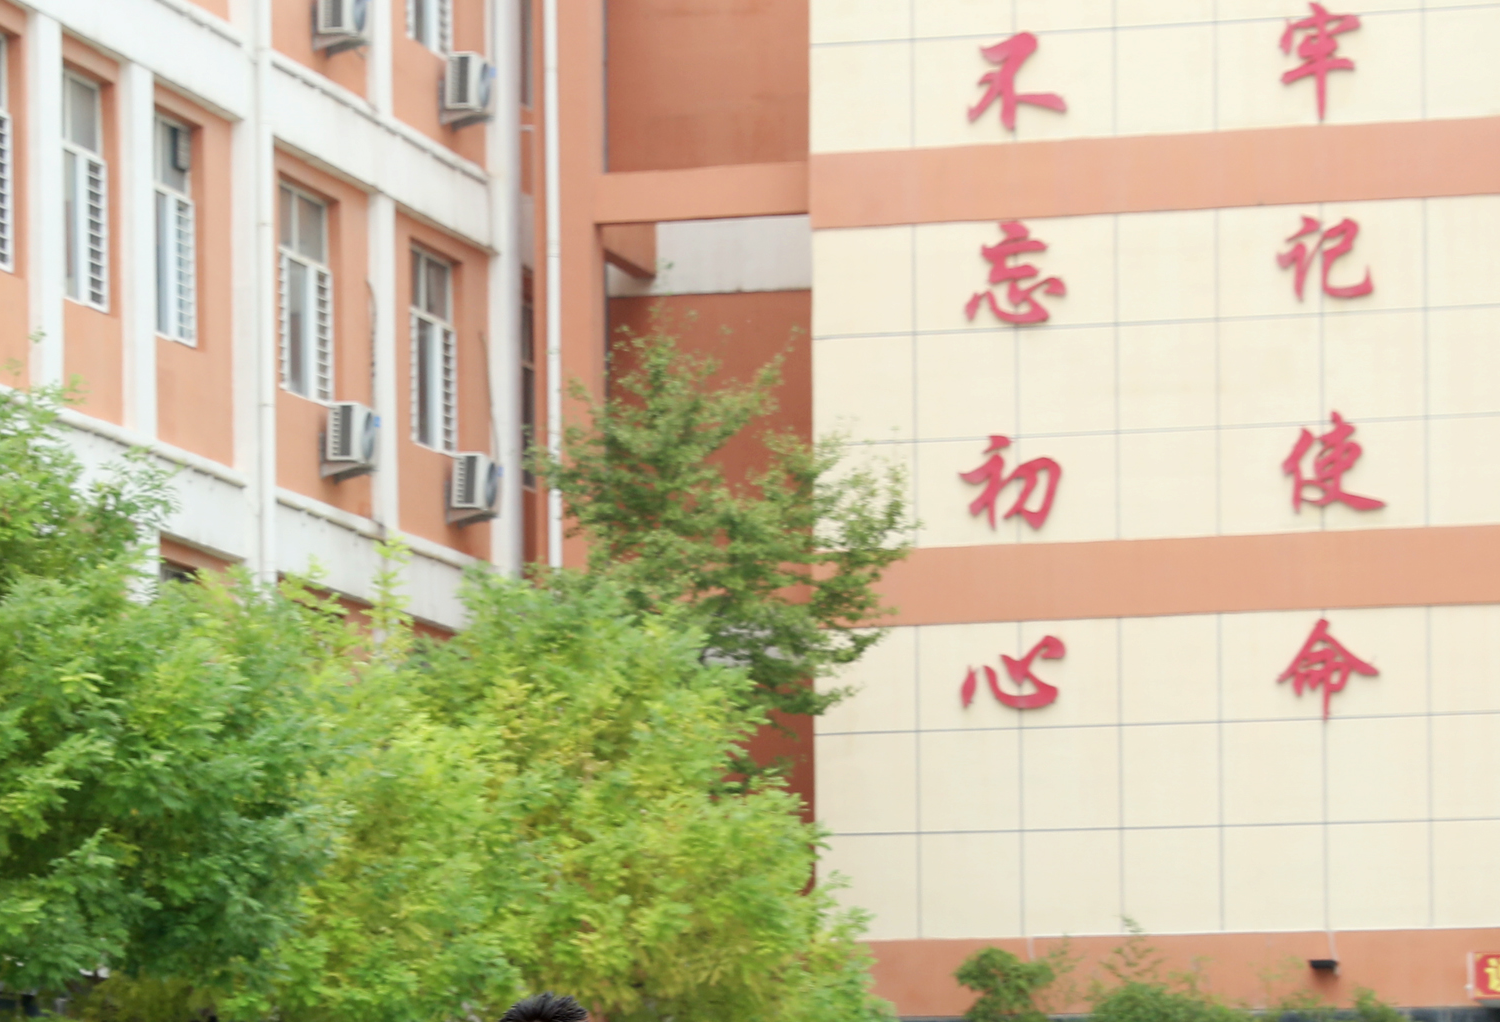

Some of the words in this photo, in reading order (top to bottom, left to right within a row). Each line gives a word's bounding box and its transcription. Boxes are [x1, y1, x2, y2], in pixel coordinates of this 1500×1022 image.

[959, 30, 1068, 711] 不忘初心
[1276, 2, 1387, 722] 牢记使命
